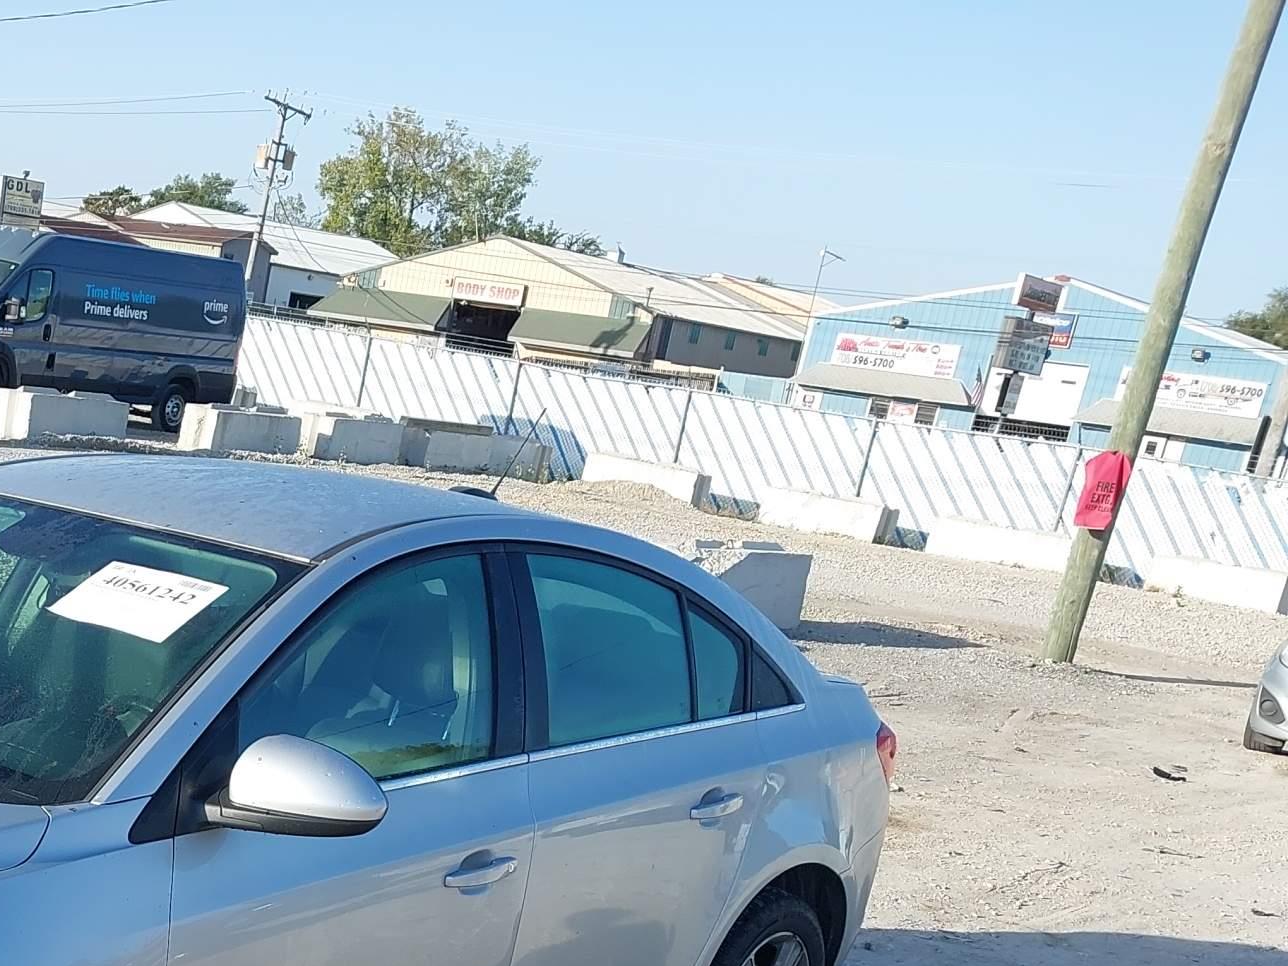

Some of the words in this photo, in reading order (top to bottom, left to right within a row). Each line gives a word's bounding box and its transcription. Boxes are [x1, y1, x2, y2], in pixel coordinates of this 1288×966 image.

[7, 178, 30, 193] GDL
[86, 284, 109, 299] Time
[112, 287, 130, 302] flies
[131, 289, 156, 304] when
[457, 281, 487, 297] BODY
[488, 285, 520, 301] SHOP
[84, 301, 112, 316] Prime
[113, 304, 149, 321] delivers
[203, 299, 229, 314] prime
[852, 355, 895, 369] 596-5700
[1219, 383, 1264, 398] 596-5700
[1096, 481, 1116, 493] FIRE
[1090, 492, 1113, 505] EXTG.
[103, 575, 197, 605] 40561242
